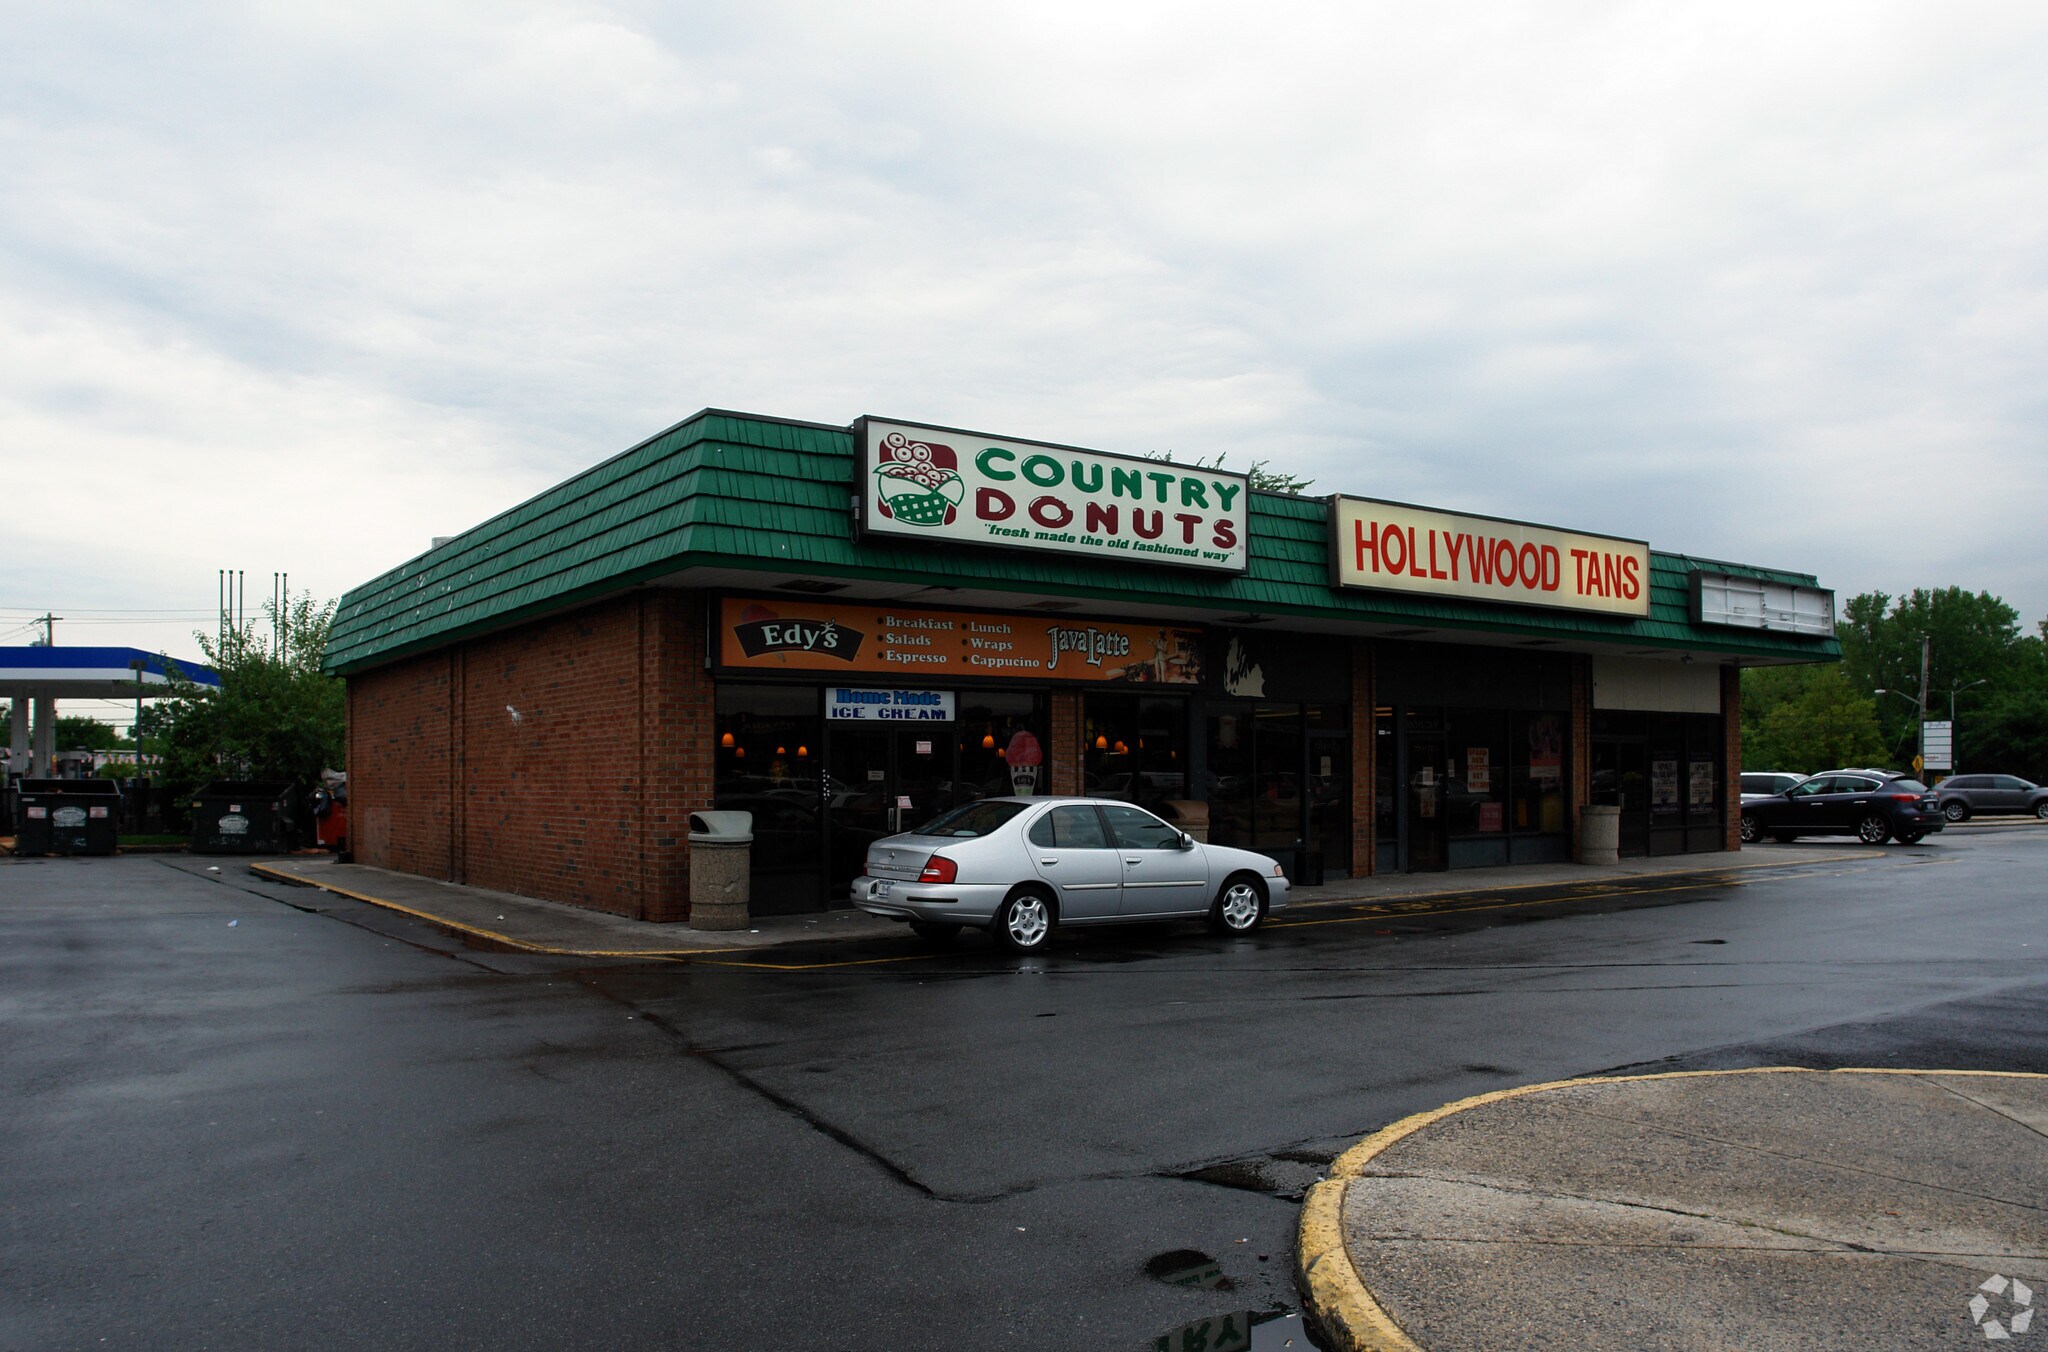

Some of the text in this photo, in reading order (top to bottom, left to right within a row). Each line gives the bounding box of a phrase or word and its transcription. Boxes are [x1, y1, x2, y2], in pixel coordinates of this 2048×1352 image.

[975, 447, 1241, 512] COUNTRY
[976, 487, 1238, 549] DONUTS
[1034, 531, 1076, 543] made
[1080, 535, 1104, 546] the
[1107, 538, 1130, 550] old
[1132, 541, 1200, 558] fashioned
[1354, 519, 1640, 600] HOLLYWOOD TANS
[886, 615, 954, 631] Breakfast
[970, 621, 1011, 634] Lunch
[761, 618, 839, 651] Edy's
[886, 632, 931, 646] Salads
[970, 638, 1013, 652] Wraps
[886, 649, 947, 664] Espresso
[970, 654, 1041, 668] Cappucino
[836, 688, 942, 706] Home Made
[832, 706, 947, 720] ICE CREAM
